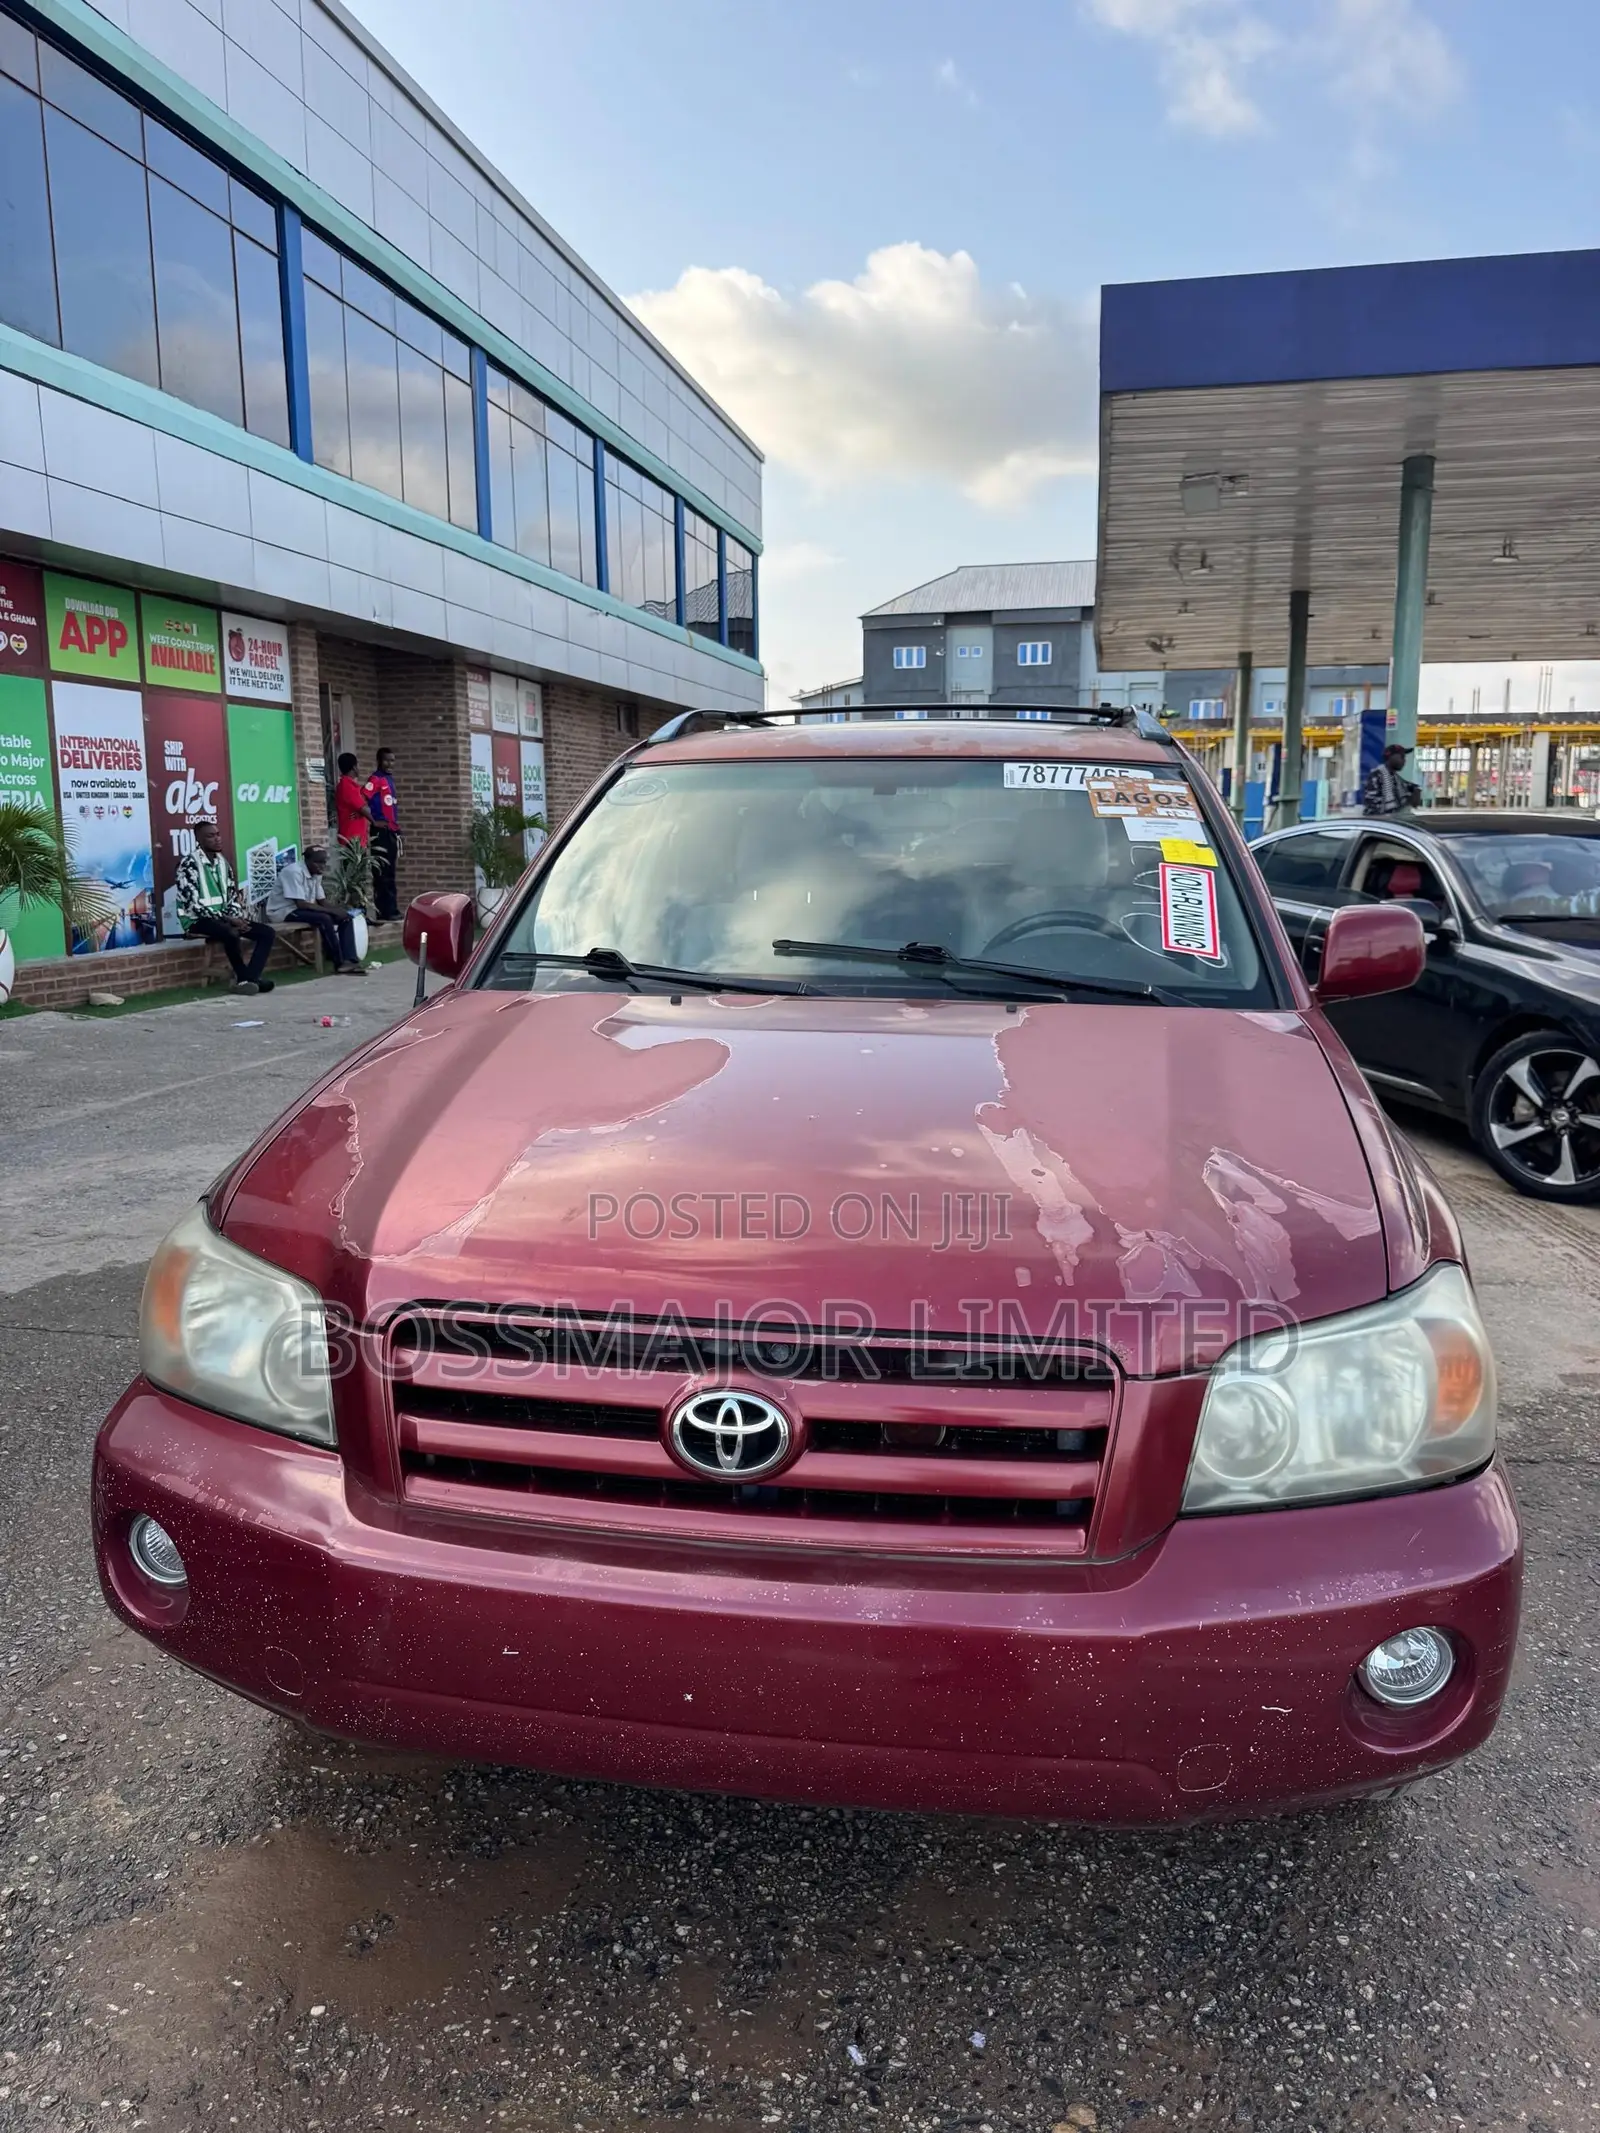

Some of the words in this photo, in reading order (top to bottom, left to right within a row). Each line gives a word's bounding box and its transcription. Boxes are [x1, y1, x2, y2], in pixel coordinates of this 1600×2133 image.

[10, 613, 37, 626] GHANA
[59, 611, 128, 658] APP
[149, 633, 170, 645] WEST
[170, 637, 195, 650] COAST
[248, 637, 283, 657] 24-HOUR
[151, 644, 216, 676] AVAILABLE
[229, 667, 241, 677] WE
[241, 669, 258, 679] WILL
[258, 671, 285, 683] DELIVER
[229, 677, 236, 685] IT
[237, 678, 250, 687] THE
[251, 680, 269, 689] NEXT
[60, 735, 140, 752] INTERNATIONAL
[164, 740, 184, 756] SHIP
[11, 753, 45, 770] Major
[60, 749, 143, 771] DELIVERIES
[164, 756, 187, 772] WITH
[71, 780, 88, 789] now
[90, 777, 127, 789] available
[128, 780, 137, 789] to
[237, 783, 260, 802] GO
[263, 785, 292, 803] ABC
[1096, 791, 1192, 807] LAGOS
[1170, 869, 1206, 949] NON-RUNNING
